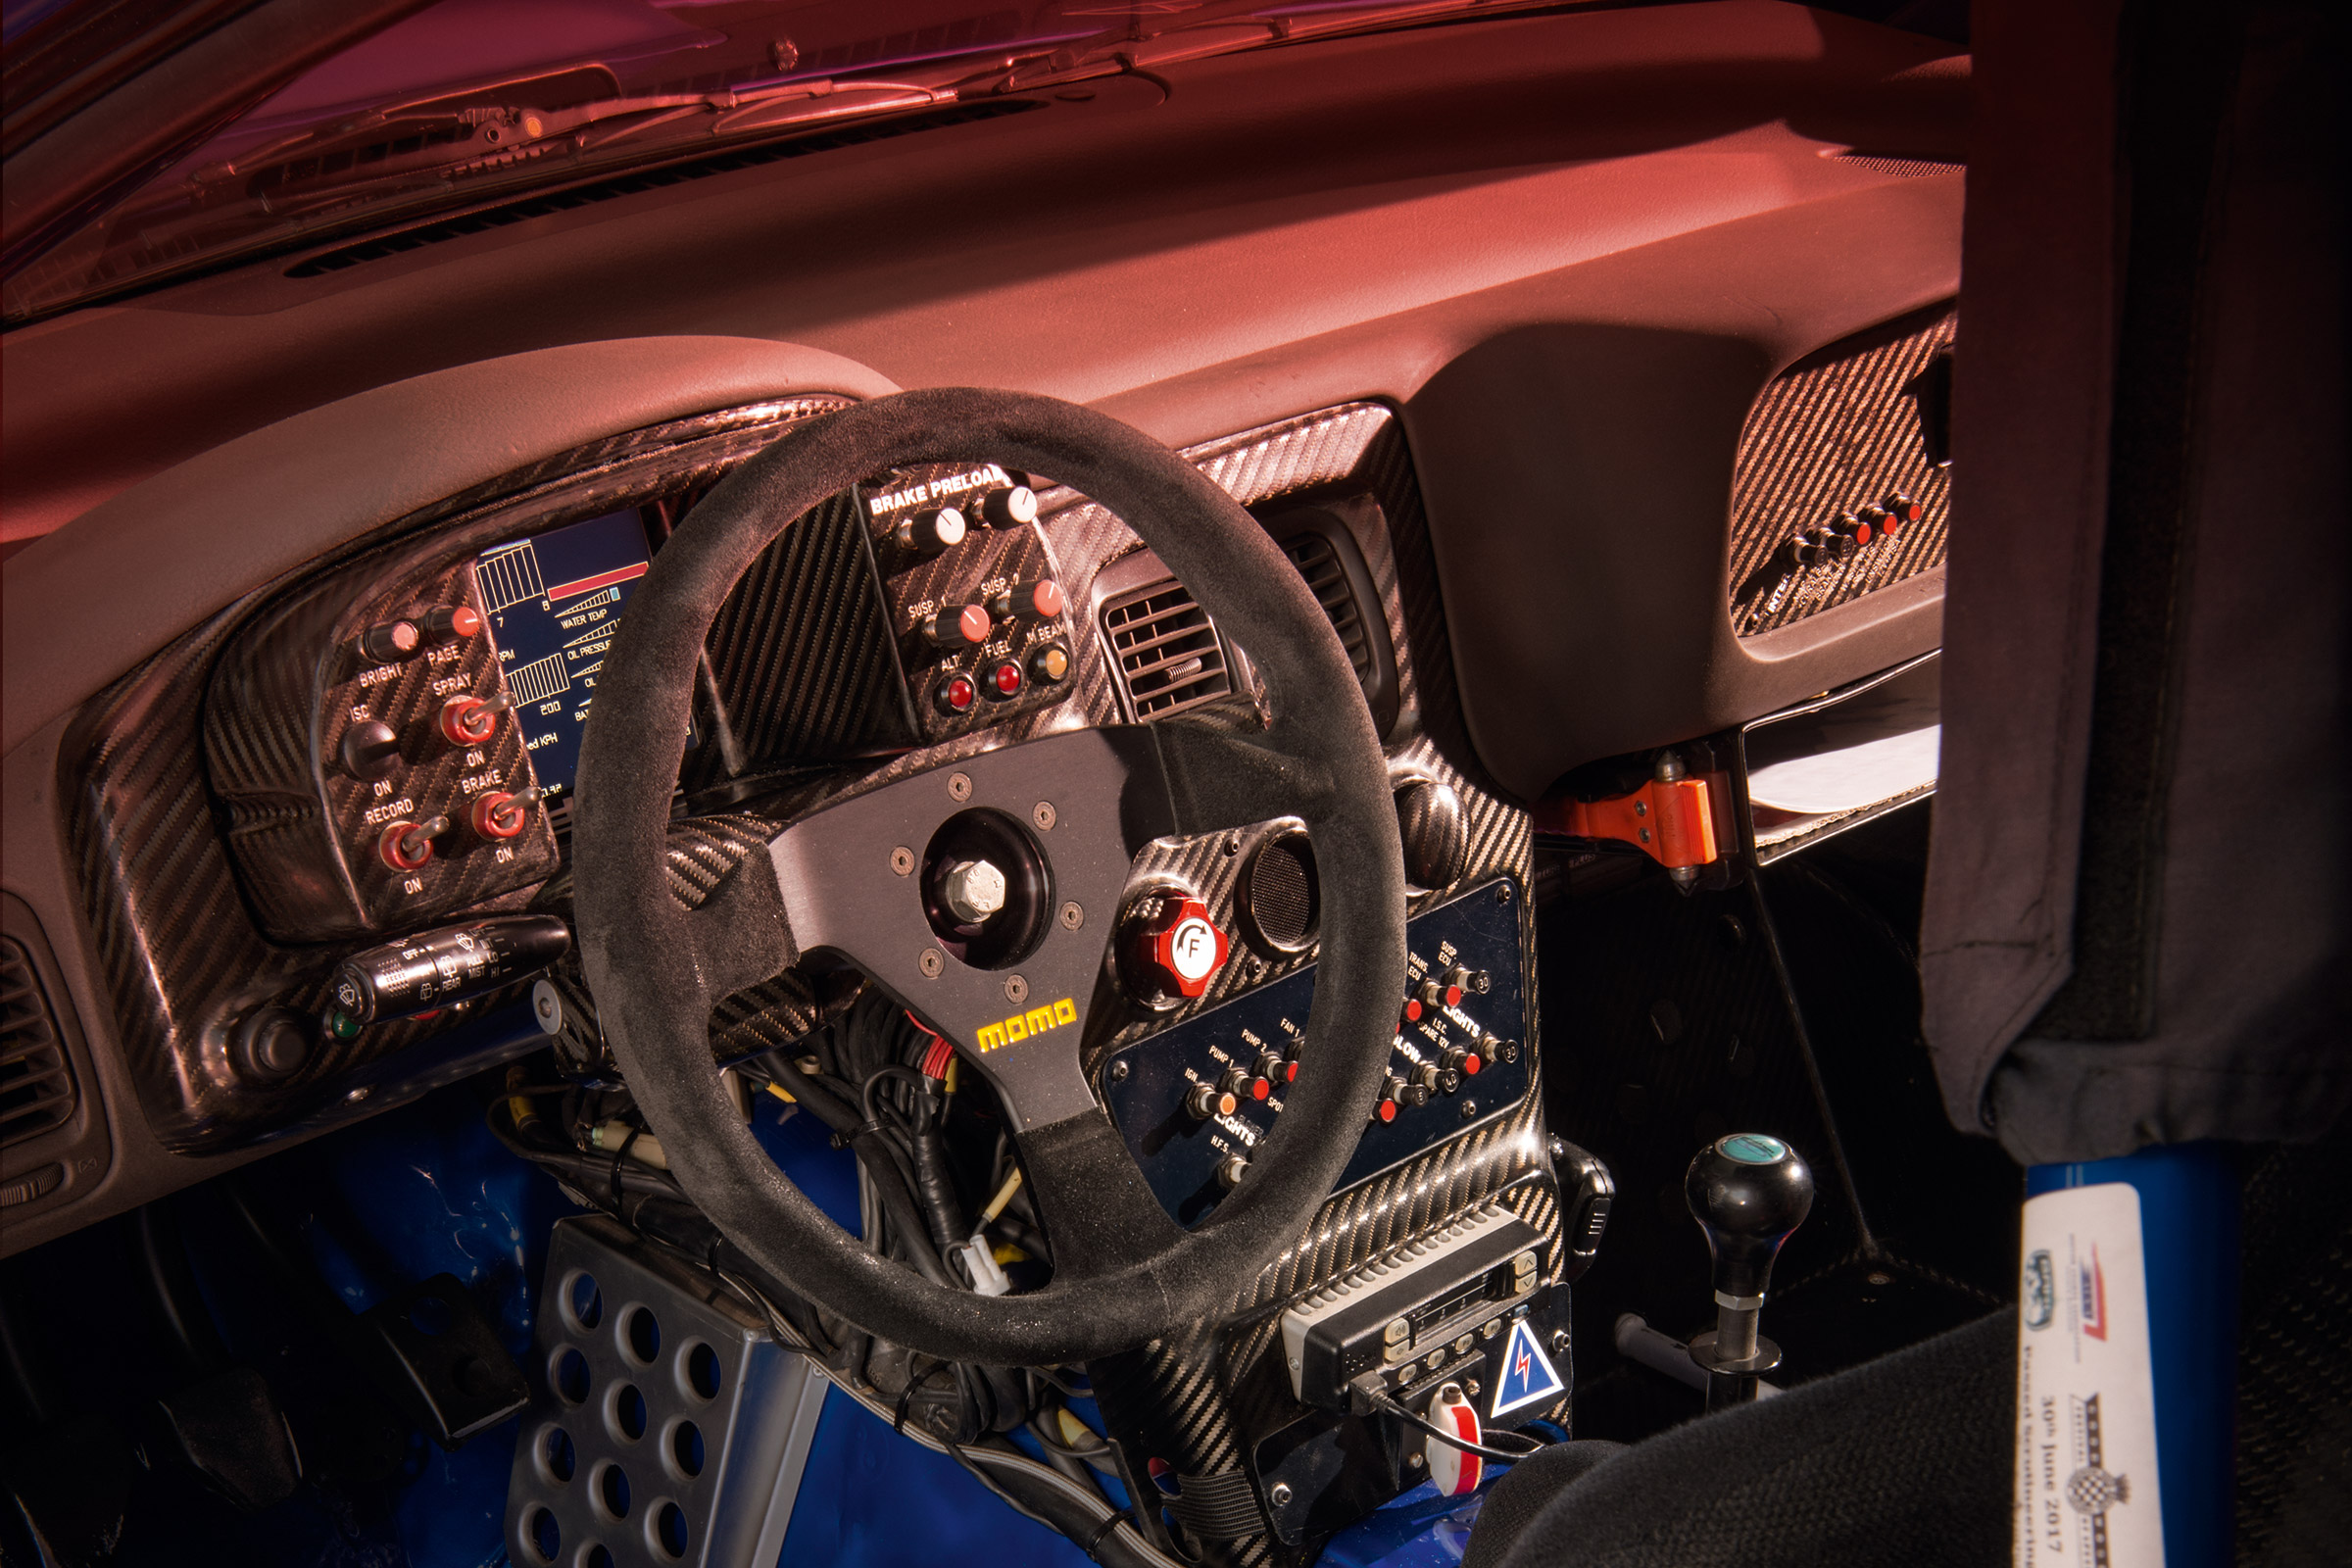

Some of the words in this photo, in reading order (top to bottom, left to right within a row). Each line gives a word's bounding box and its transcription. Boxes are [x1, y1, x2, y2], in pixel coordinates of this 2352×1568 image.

[869, 485, 928, 515] BRAKE
[929, 466, 1004, 499] PRELOAD
[980, 577, 1006, 595] SUSP
[542, 600, 551, 612] 8
[907, 600, 934, 618] SUSP
[497, 617, 504, 627] 7
[561, 615, 587, 630] WATER
[588, 609, 608, 624] TEMP
[427, 645, 461, 666] PAGE
[567, 650, 581, 661] OIL
[985, 640, 1011, 658] FUEL
[359, 662, 403, 688] BRIGHT
[433, 673, 472, 697] SPRAY
[349, 704, 370, 722] ISC
[540, 701, 562, 715] 200
[540, 732, 558, 747] KPH
[466, 750, 485, 767] ON
[374, 780, 393, 797] ON
[462, 769, 503, 794] BRAKE
[365, 799, 415, 825] RECORD
[496, 847, 514, 863] ON
[404, 877, 422, 895] ON
[402, 948, 419, 960] OFF
[1189, 938, 1200, 958] F
[1408, 951, 1429, 973] TRANS.
[1438, 951, 1452, 966] ECU
[491, 966, 500, 978] HI
[1407, 965, 1422, 981] ECU
[442, 977, 461, 992] REAR
[1479, 976, 1489, 990] 30
[1280, 1017, 1296, 1034] FAN
[1295, 1028, 1300, 1038] 1
[1241, 1029, 1261, 1048] PUMP
[1260, 1043, 1268, 1054] 2
[1208, 1045, 1229, 1063] PUMP
[1229, 1058, 1235, 1068] 1
[1184, 1067, 1198, 1084] IGN.
[2040, 1444, 2057, 1493] June
[2045, 1498, 2063, 1554] 2017
